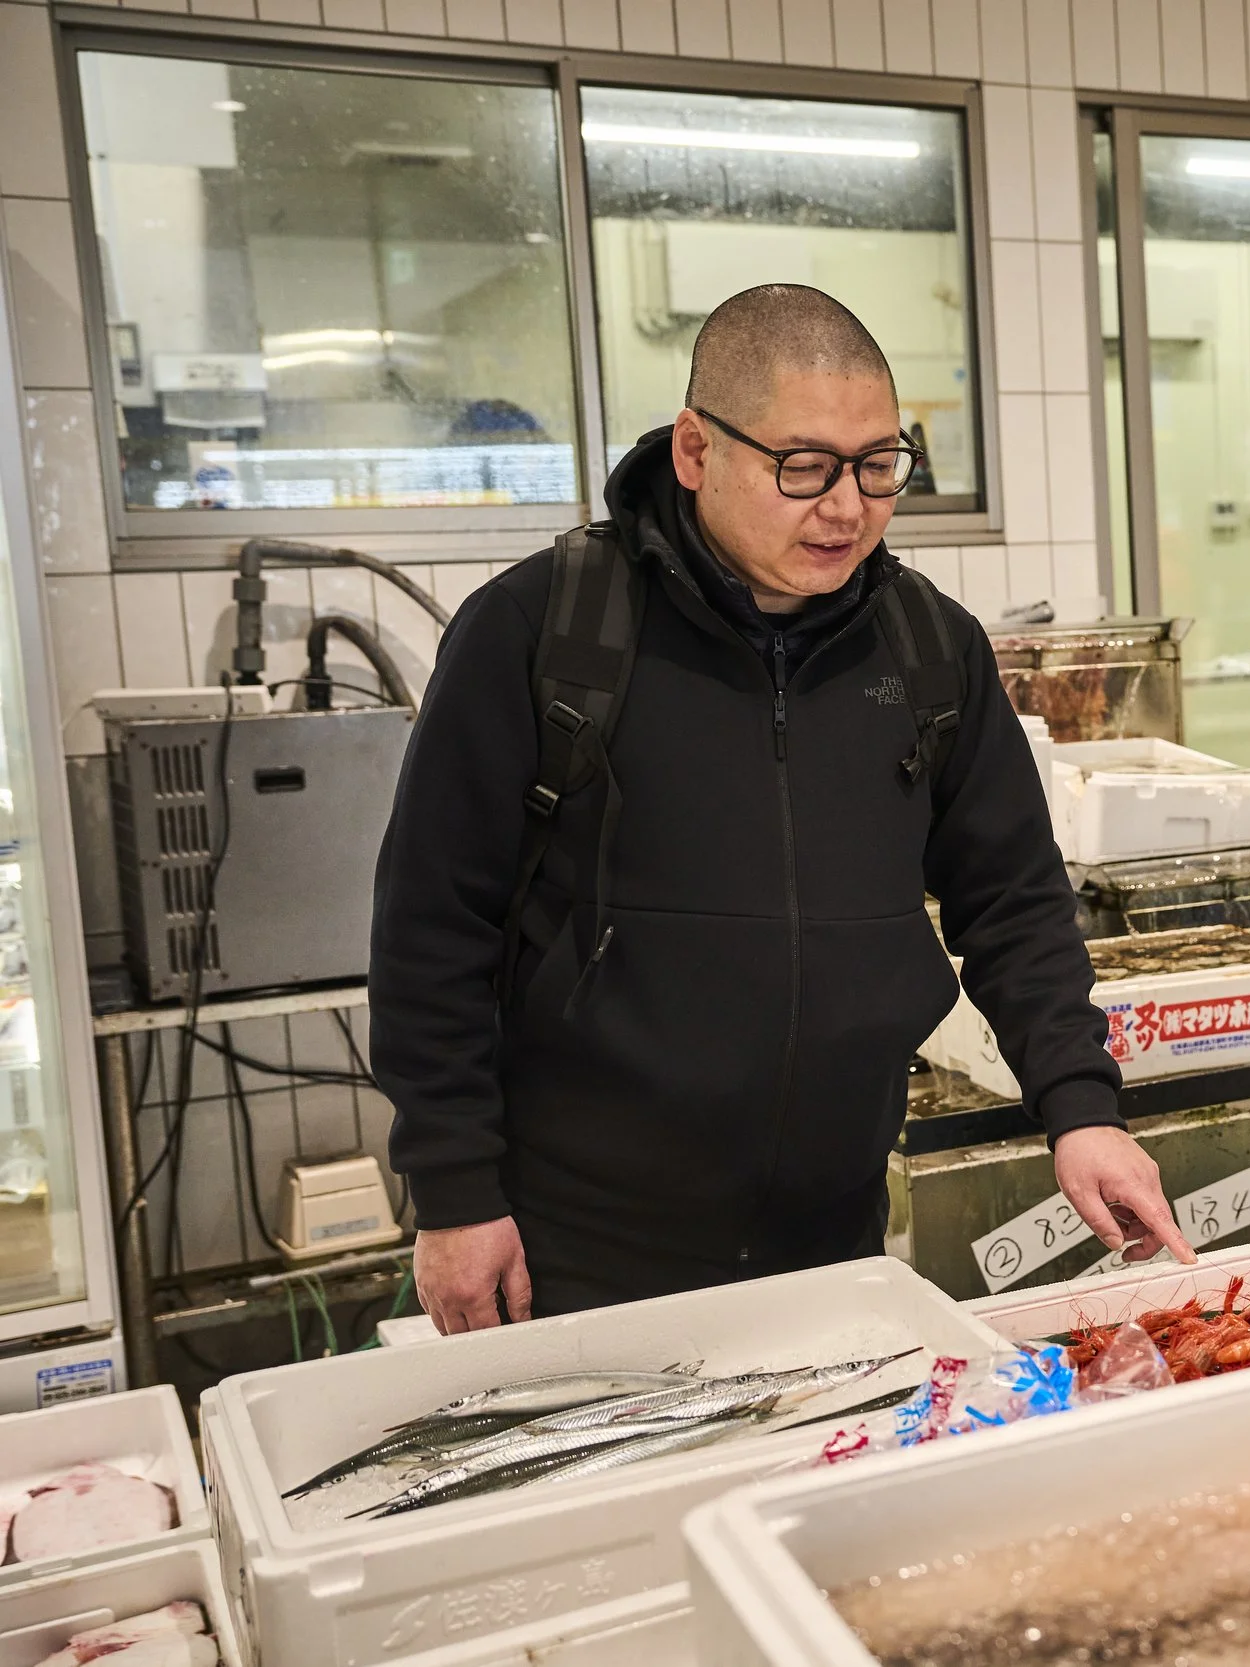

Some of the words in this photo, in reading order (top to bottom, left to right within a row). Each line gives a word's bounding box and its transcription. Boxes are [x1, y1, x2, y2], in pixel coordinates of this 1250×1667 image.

[880, 676, 902, 686] THE
[864, 685, 905, 697] NORTH
[878, 694, 905, 704] FACE
